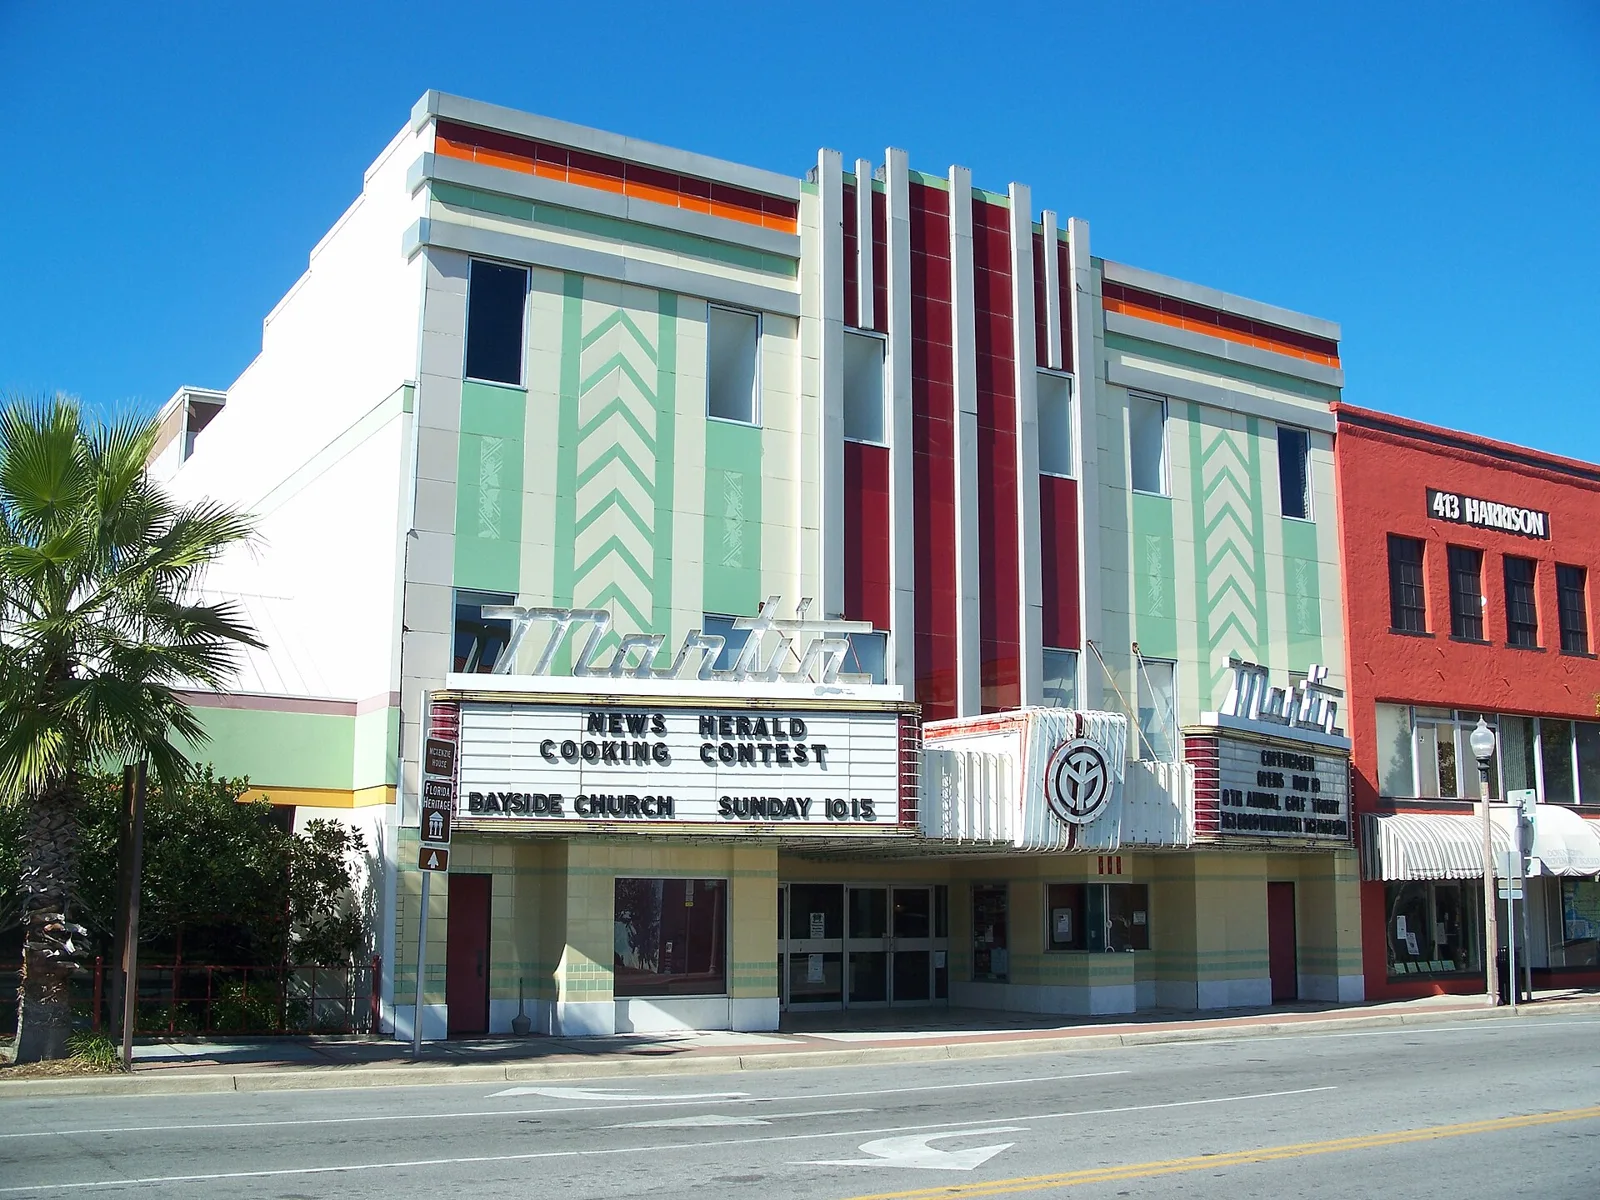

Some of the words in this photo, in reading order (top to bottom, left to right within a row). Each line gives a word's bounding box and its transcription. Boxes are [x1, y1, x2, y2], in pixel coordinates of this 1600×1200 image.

[1433, 491, 1460, 519] 413
[1464, 498, 1544, 536] HARRISON
[480, 595, 873, 685] Martin
[587, 711, 667, 736] NEWS
[699, 714, 806, 739] HERALD
[540, 738, 670, 763] COOKING
[699, 743, 829, 765] CONTEST
[423, 796, 451, 811] HERITAGE
[425, 782, 450, 797] FLORIDA
[468, 792, 563, 817] BAYSIDE
[574, 794, 675, 818] CHURCH
[718, 796, 811, 820] SUNDAY
